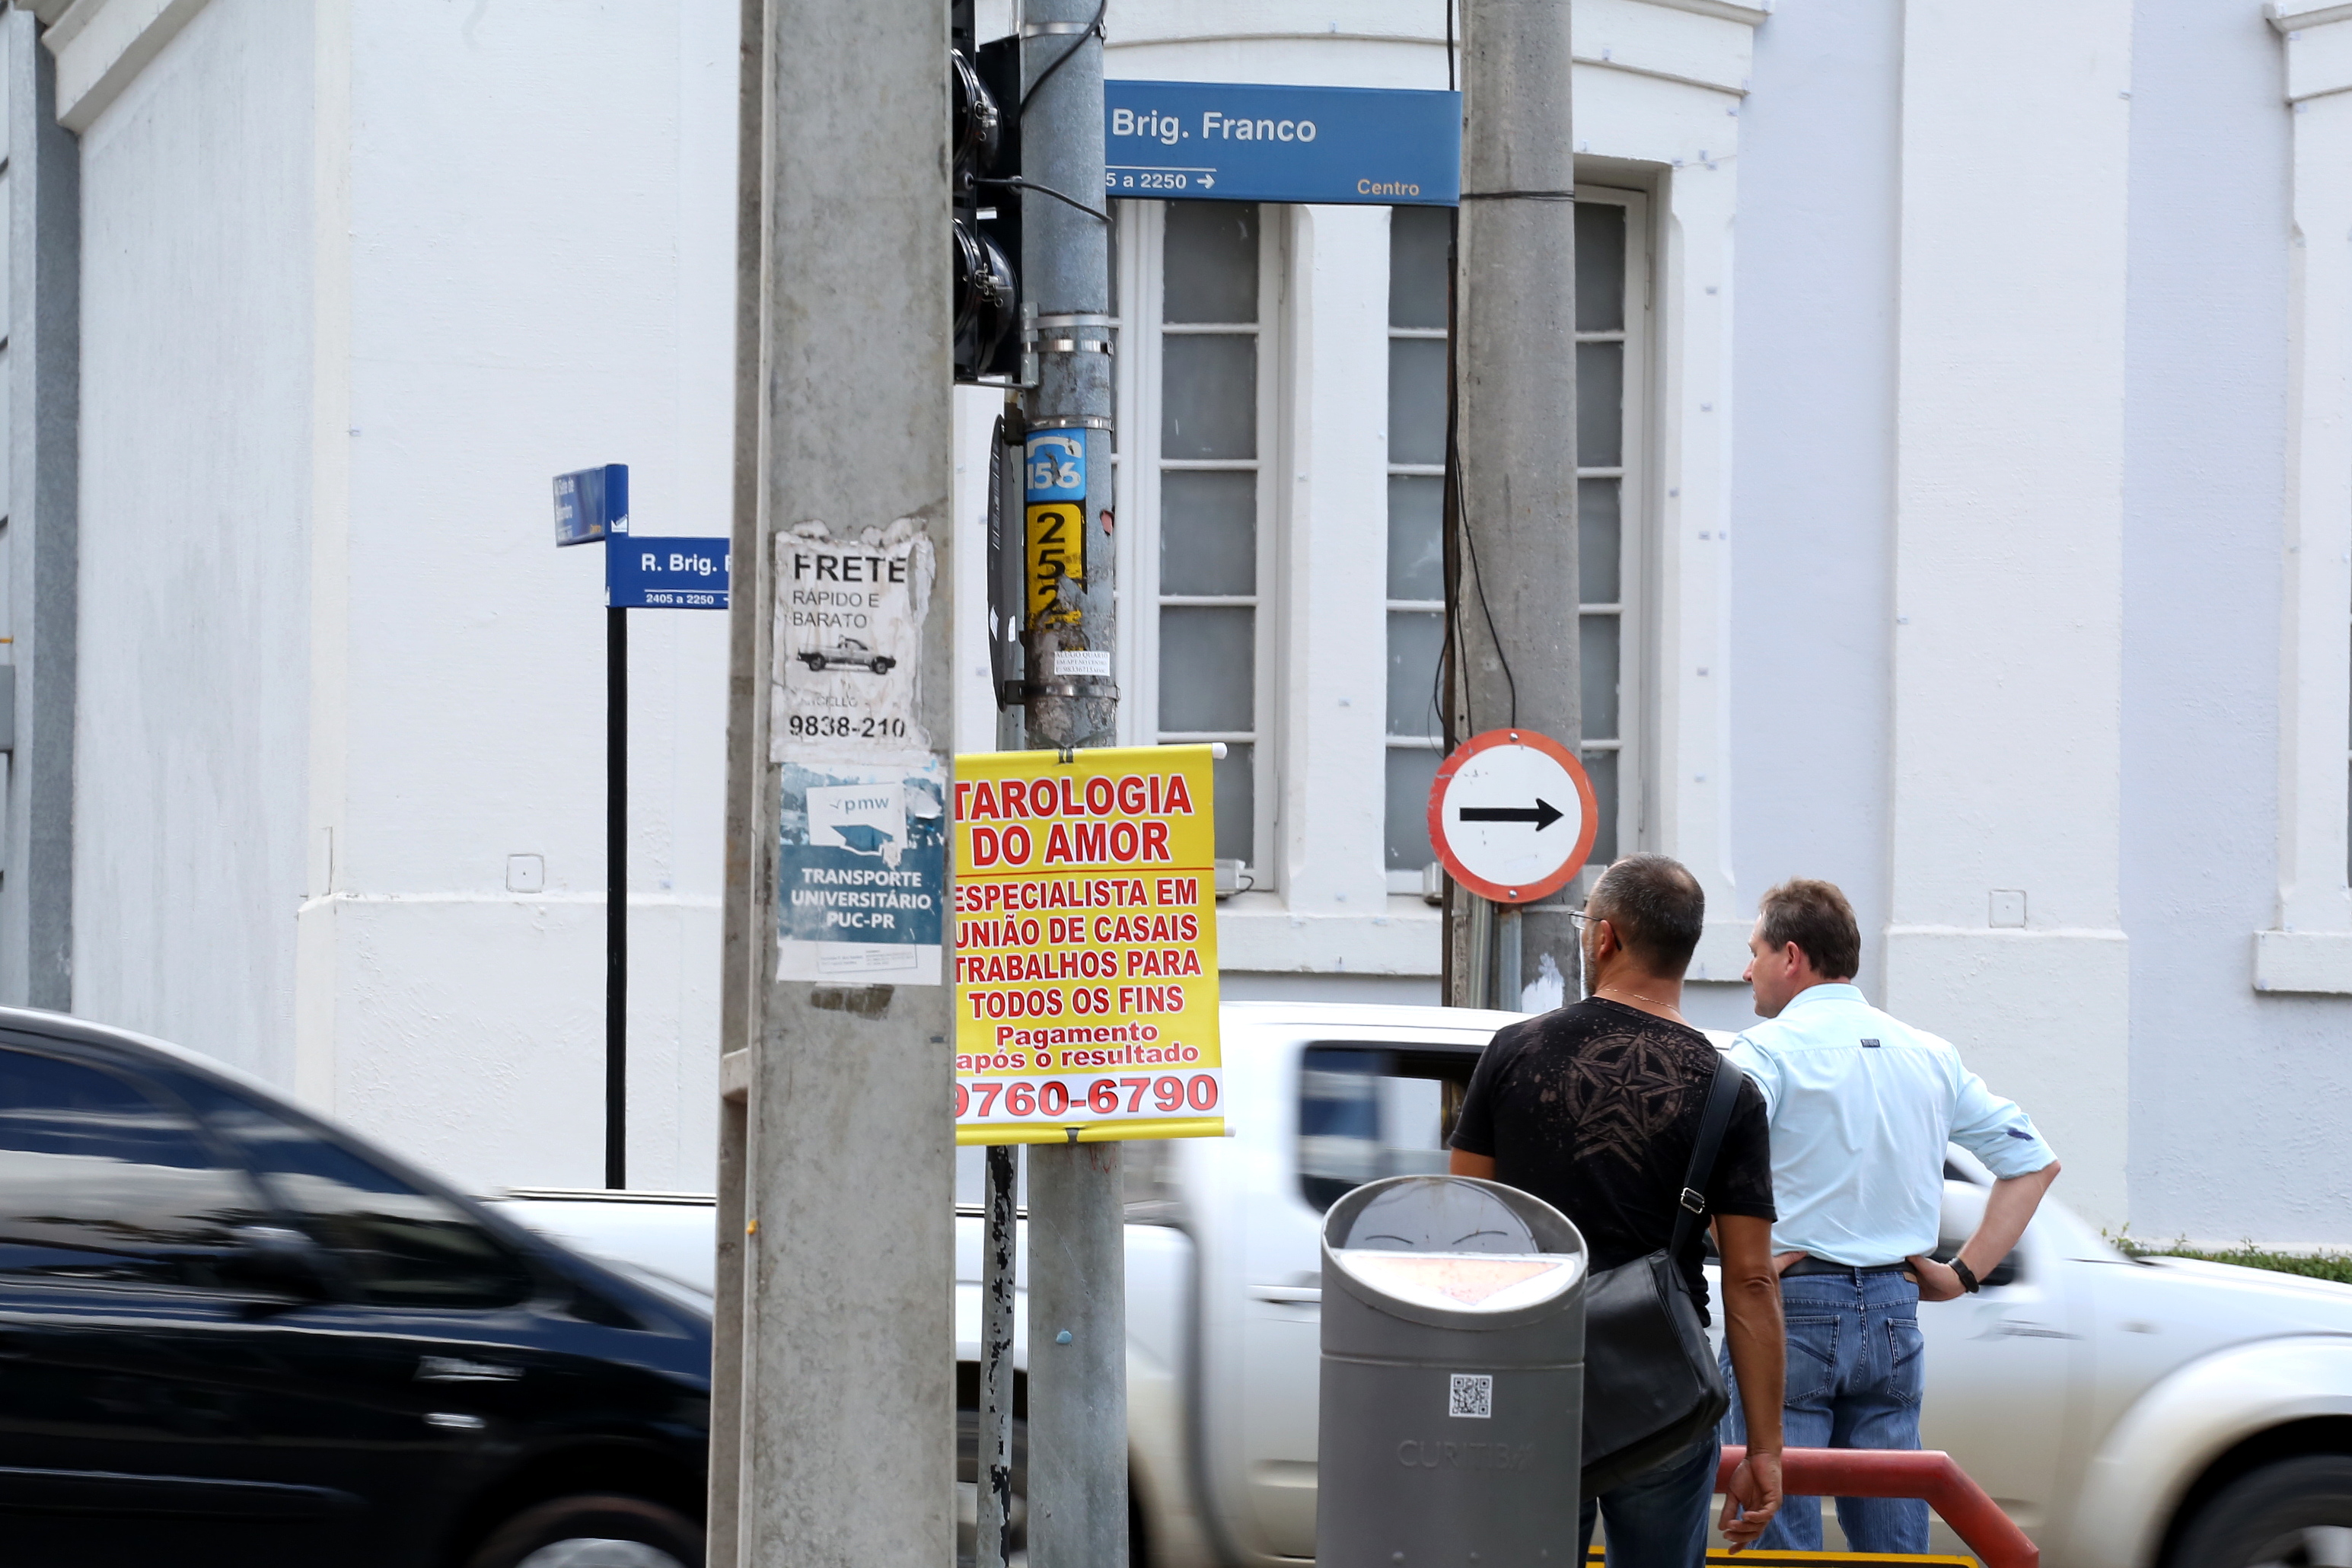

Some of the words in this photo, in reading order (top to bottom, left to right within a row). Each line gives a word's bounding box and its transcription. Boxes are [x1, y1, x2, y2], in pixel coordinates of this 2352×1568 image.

[1112, 108, 1189, 145] Brig.
[1203, 111, 1317, 143] Franco
[1123, 175, 1134, 188] a
[1140, 173, 1187, 190] 2250
[1356, 178, 1420, 196] Centro
[1027, 461, 1081, 489] 156
[641, 553, 662, 572] R.
[669, 554, 718, 576] Brig.
[794, 553, 907, 583] FRETE
[645, 594, 674, 604] 2405
[686, 594, 714, 604] 2250
[792, 588, 862, 607] RÁPIDO
[868, 593, 880, 607] E
[792, 612, 868, 628] BARATO
[844, 797, 889, 814] pmw
[955, 776, 1194, 821] TAROLOGIA
[973, 825, 1031, 867] DO
[1045, 821, 1171, 863] AMOR
[802, 868, 923, 888] TRANSPORTE
[791, 889, 932, 910] UNIVERSITÁRIO
[955, 880, 1148, 913] ESPECIALISTA
[1157, 878, 1197, 905] EM
[826, 910, 896, 929] PUC-PR
[955, 915, 1041, 949] UNIÃO
[1050, 917, 1085, 944] DE
[1095, 914, 1198, 944] CASAIS
[955, 951, 1118, 983] TRABALHOS
[1127, 949, 1202, 977] PARA
[968, 989, 1063, 1019] TODOS
[1072, 987, 1110, 1015] OS
[1119, 986, 1184, 1013] FINS
[996, 1023, 1158, 1050] Pagamento
[956, 1048, 1026, 1075] após
[1035, 1053, 1052, 1068] o
[1062, 1043, 1199, 1067] resultado
